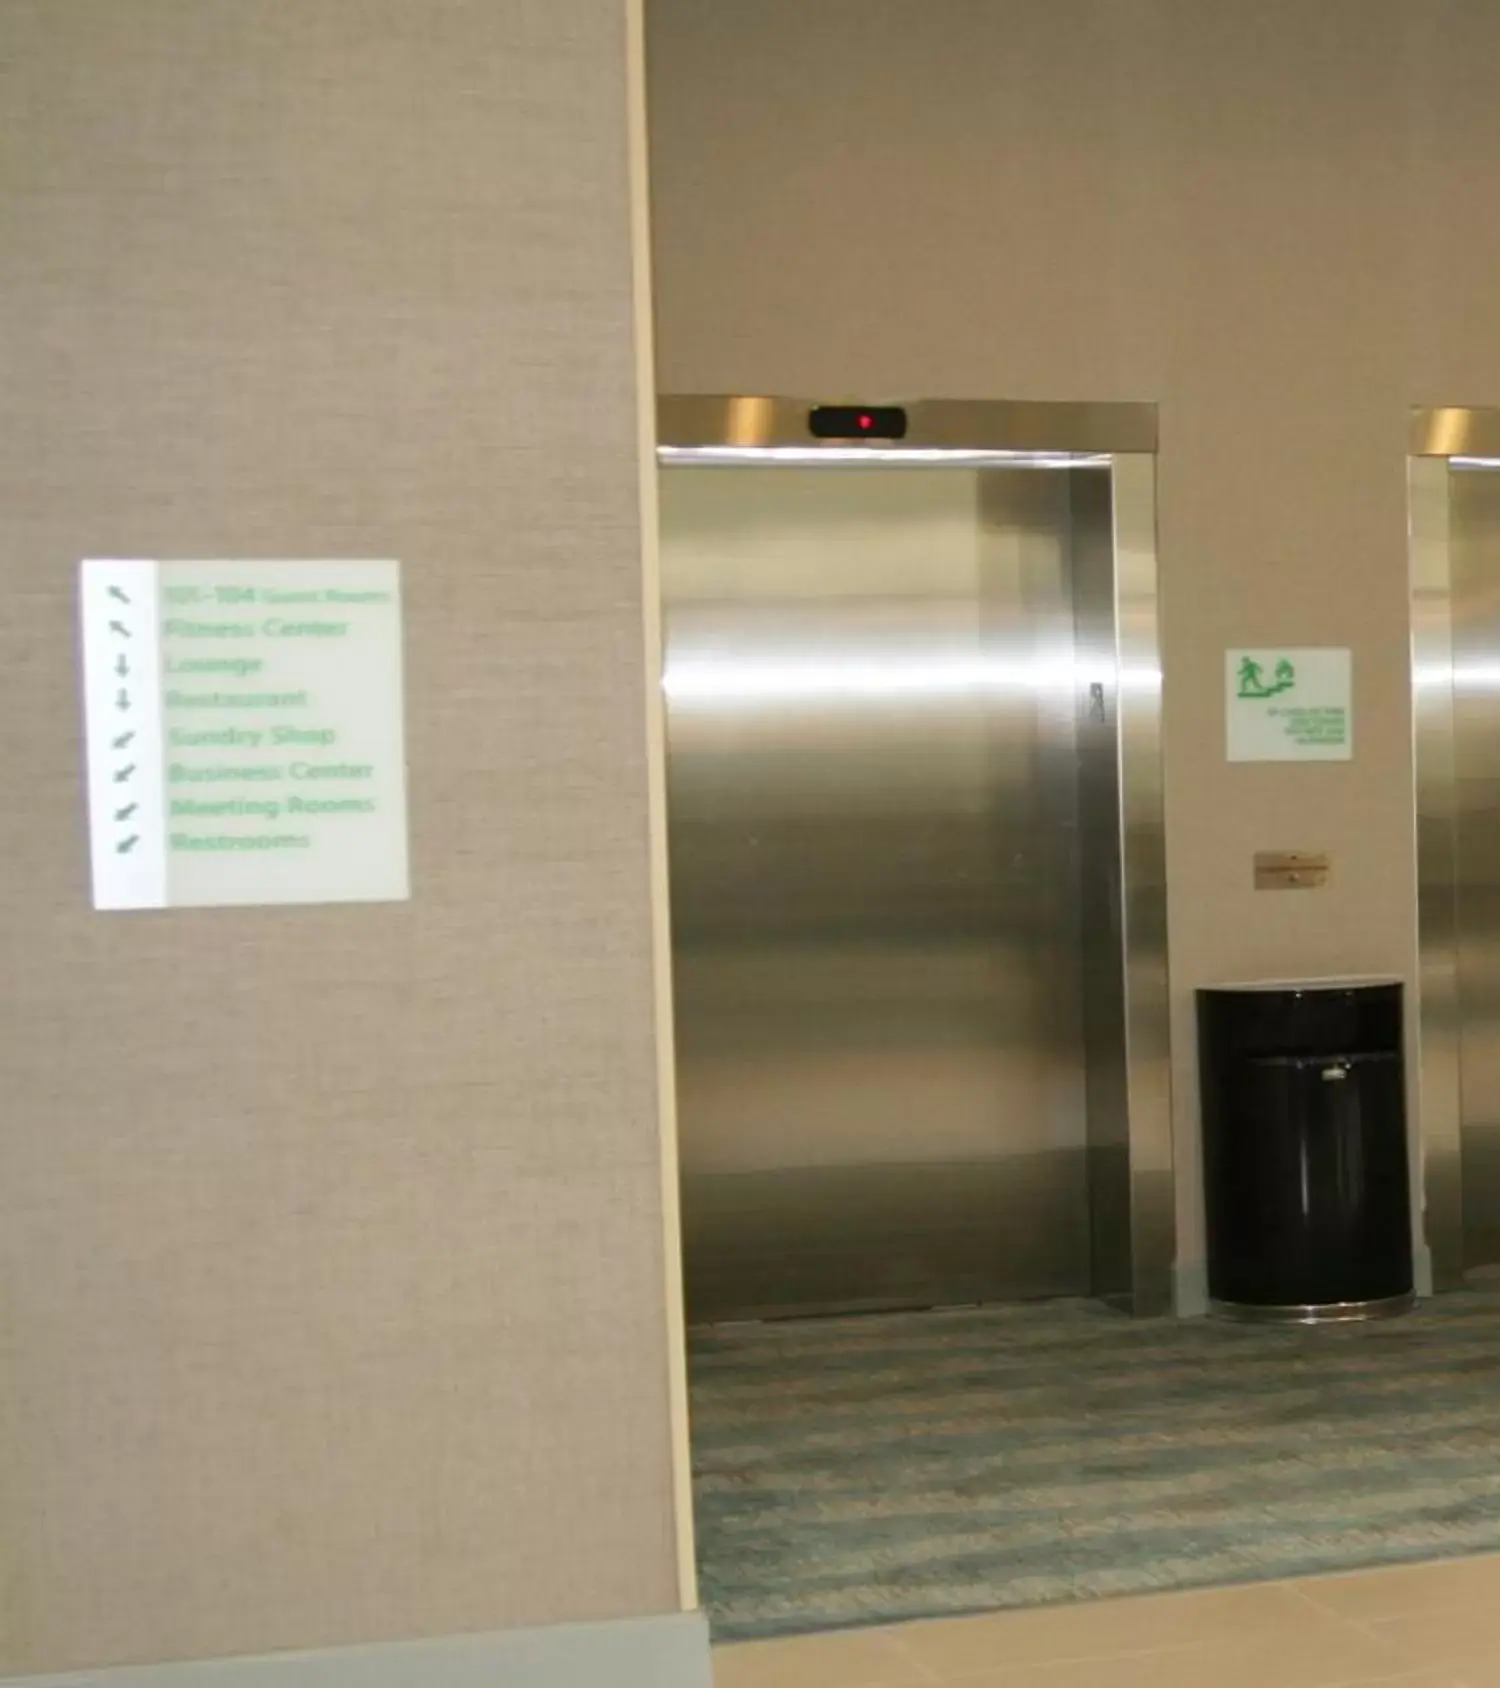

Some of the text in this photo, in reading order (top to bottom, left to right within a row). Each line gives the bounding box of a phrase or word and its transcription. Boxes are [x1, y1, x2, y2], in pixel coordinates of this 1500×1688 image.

[163, 618, 351, 638] Fitness Center
[166, 656, 264, 677] Lounge
[166, 690, 308, 709] Restaurant
[169, 725, 337, 748] Sundry Shop
[168, 761, 374, 783] Business Center
[170, 795, 377, 819] Meeting Rooms
[169, 833, 311, 852] Restrooms
